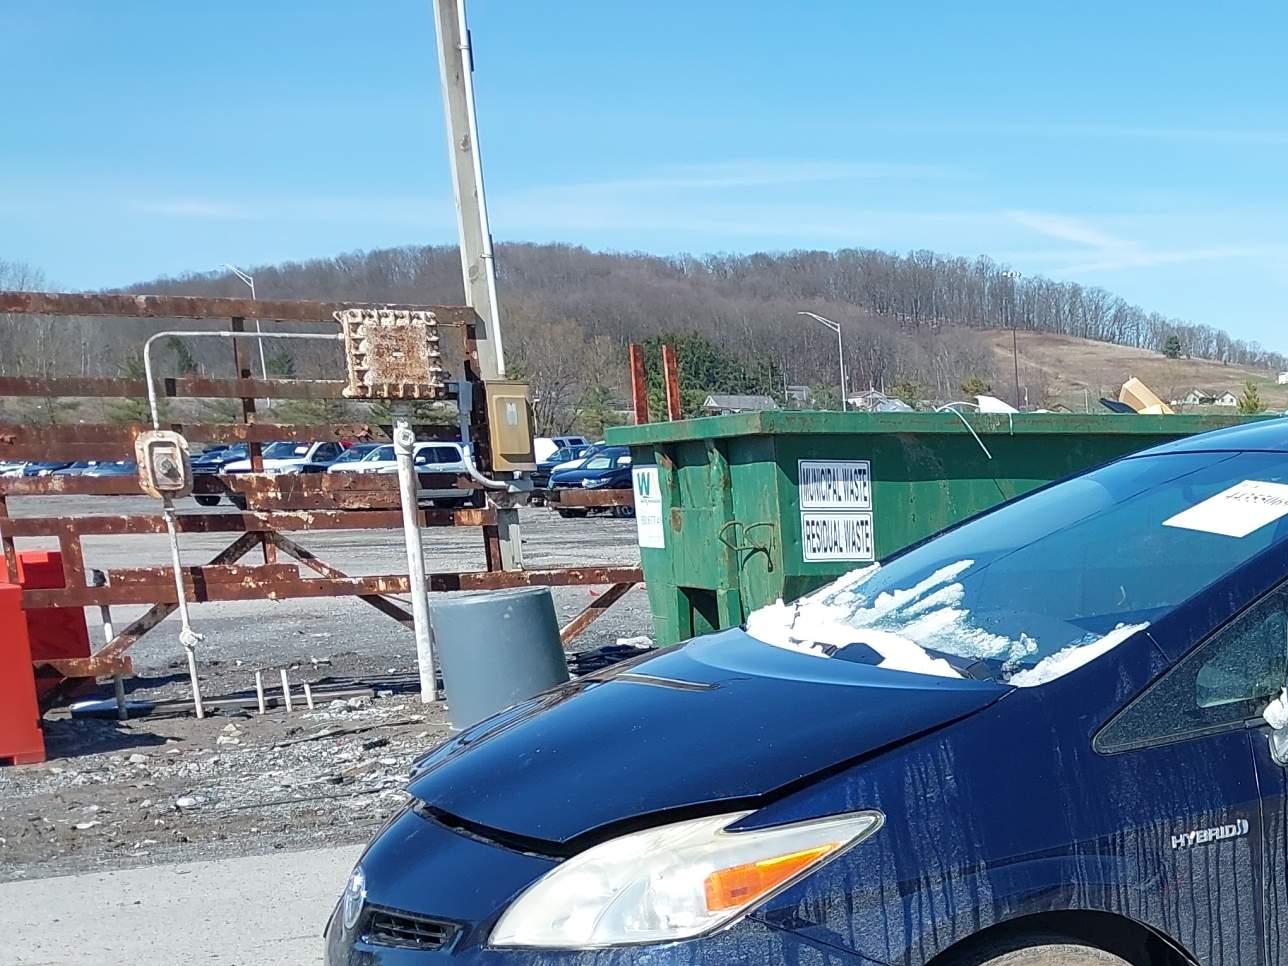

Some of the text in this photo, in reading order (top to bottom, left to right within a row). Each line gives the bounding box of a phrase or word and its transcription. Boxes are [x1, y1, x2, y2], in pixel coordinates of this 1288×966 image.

[802, 467, 868, 503] MUNICIPAL WASTE
[805, 519, 870, 554] RESIDUAL WASTE
[1171, 824, 1237, 849] HYBRID
